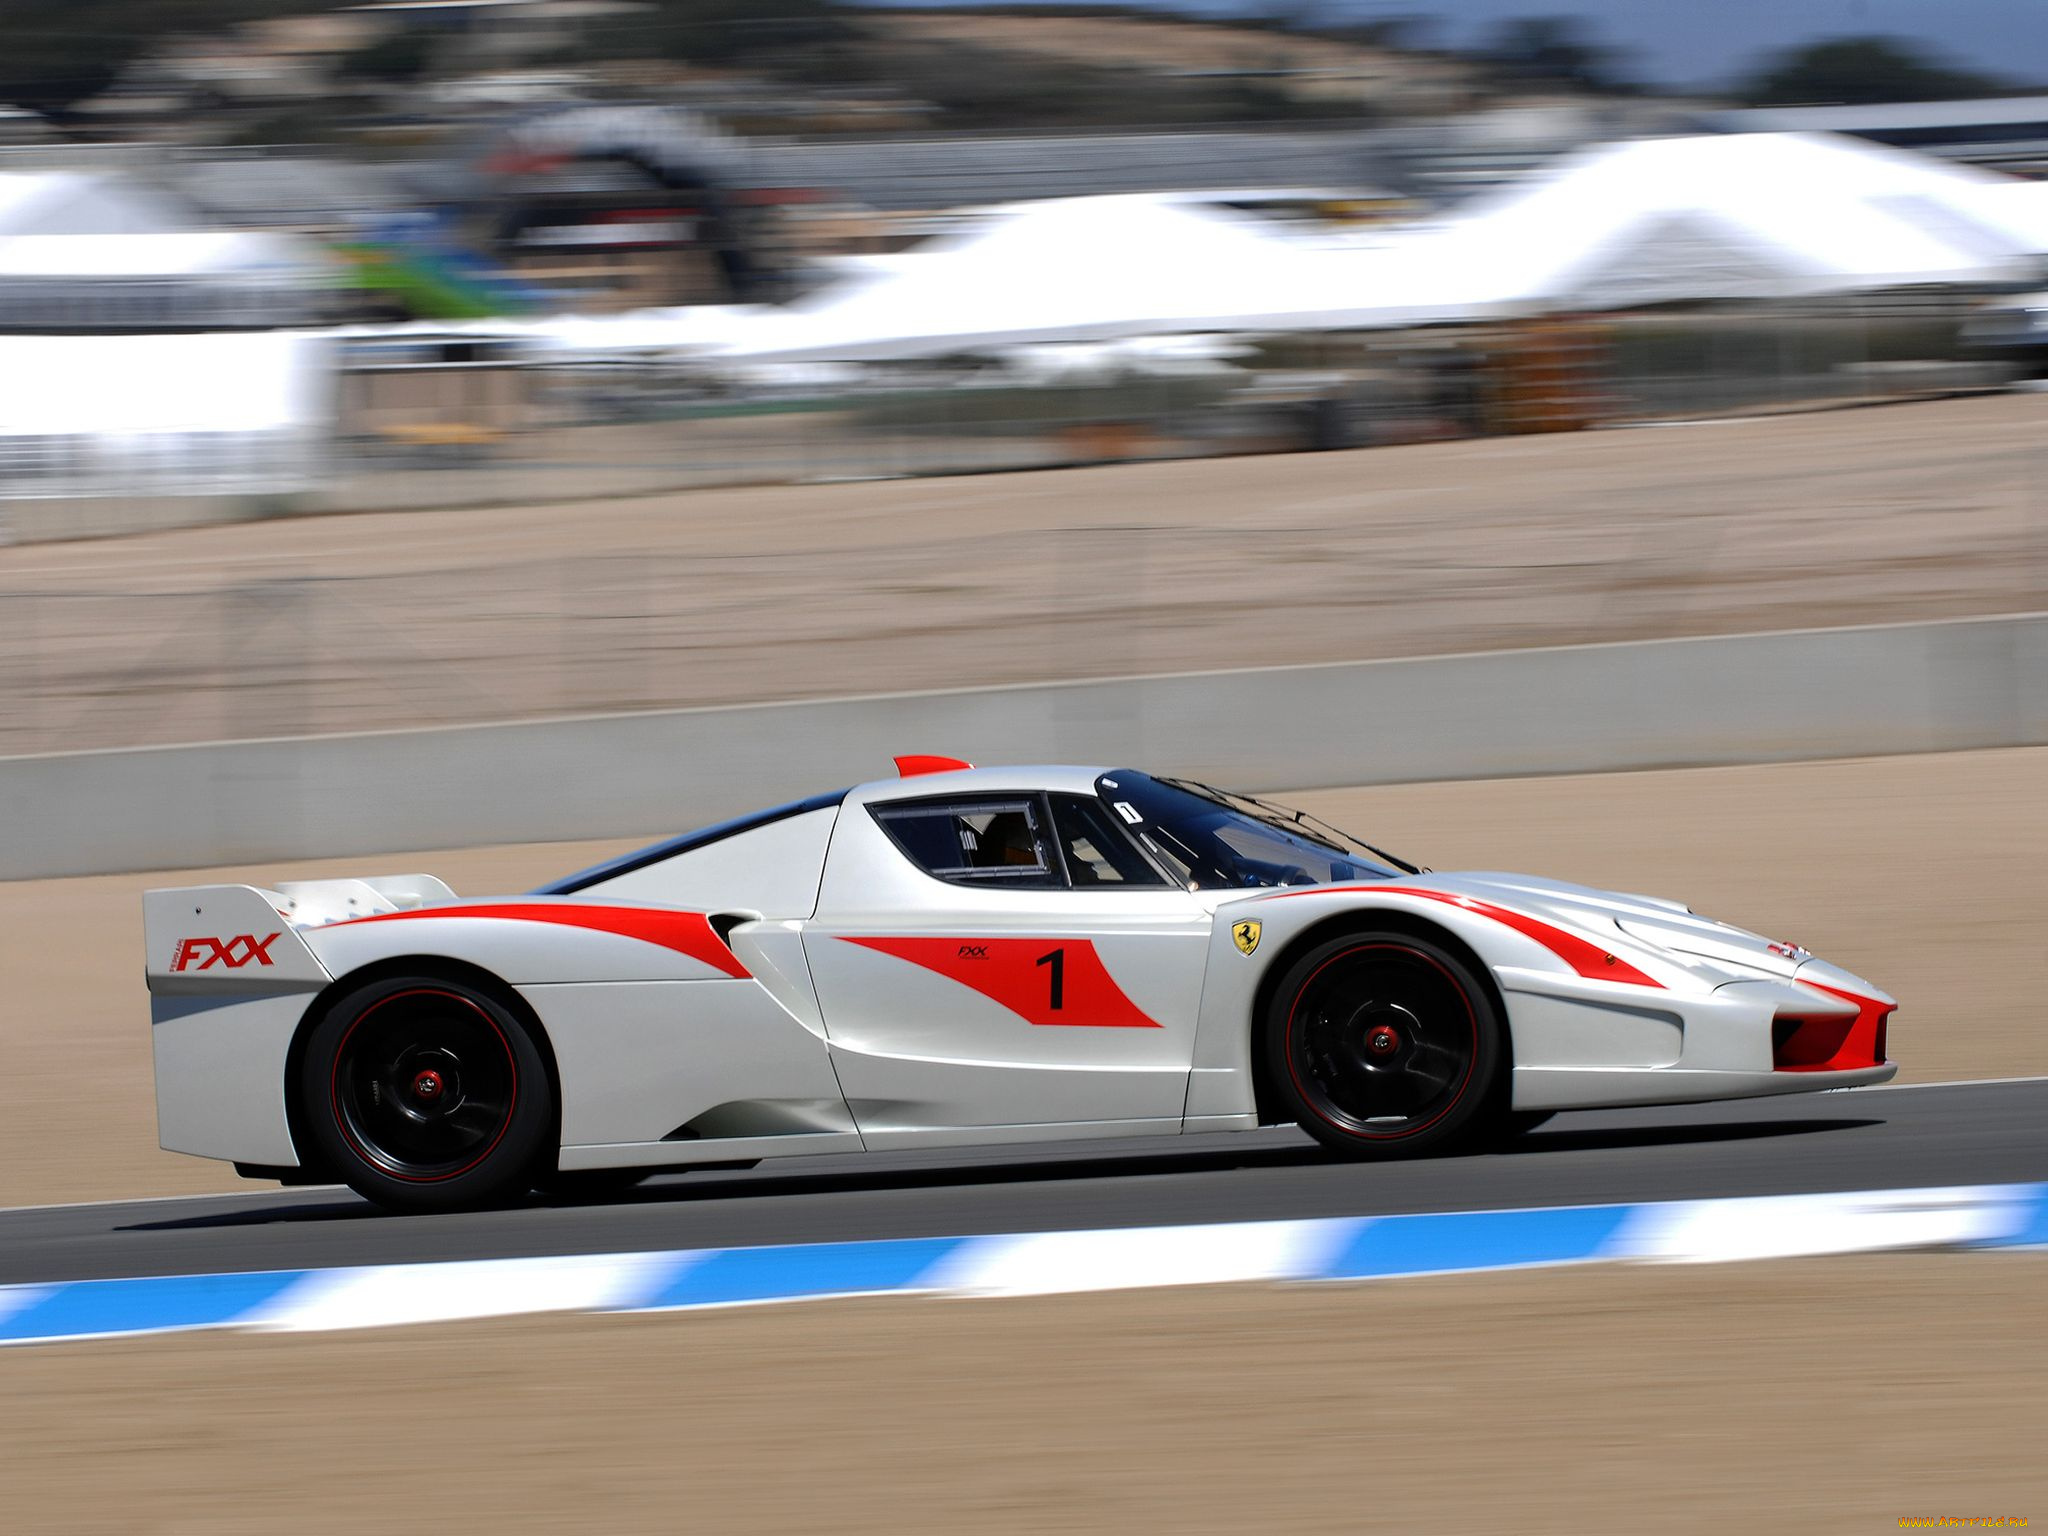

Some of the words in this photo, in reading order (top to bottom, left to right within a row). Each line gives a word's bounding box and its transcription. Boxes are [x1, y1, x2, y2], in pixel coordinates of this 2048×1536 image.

[176, 932, 282, 971] FXX
[958, 945, 989, 956] FXX
[1036, 948, 1064, 1010] 1
